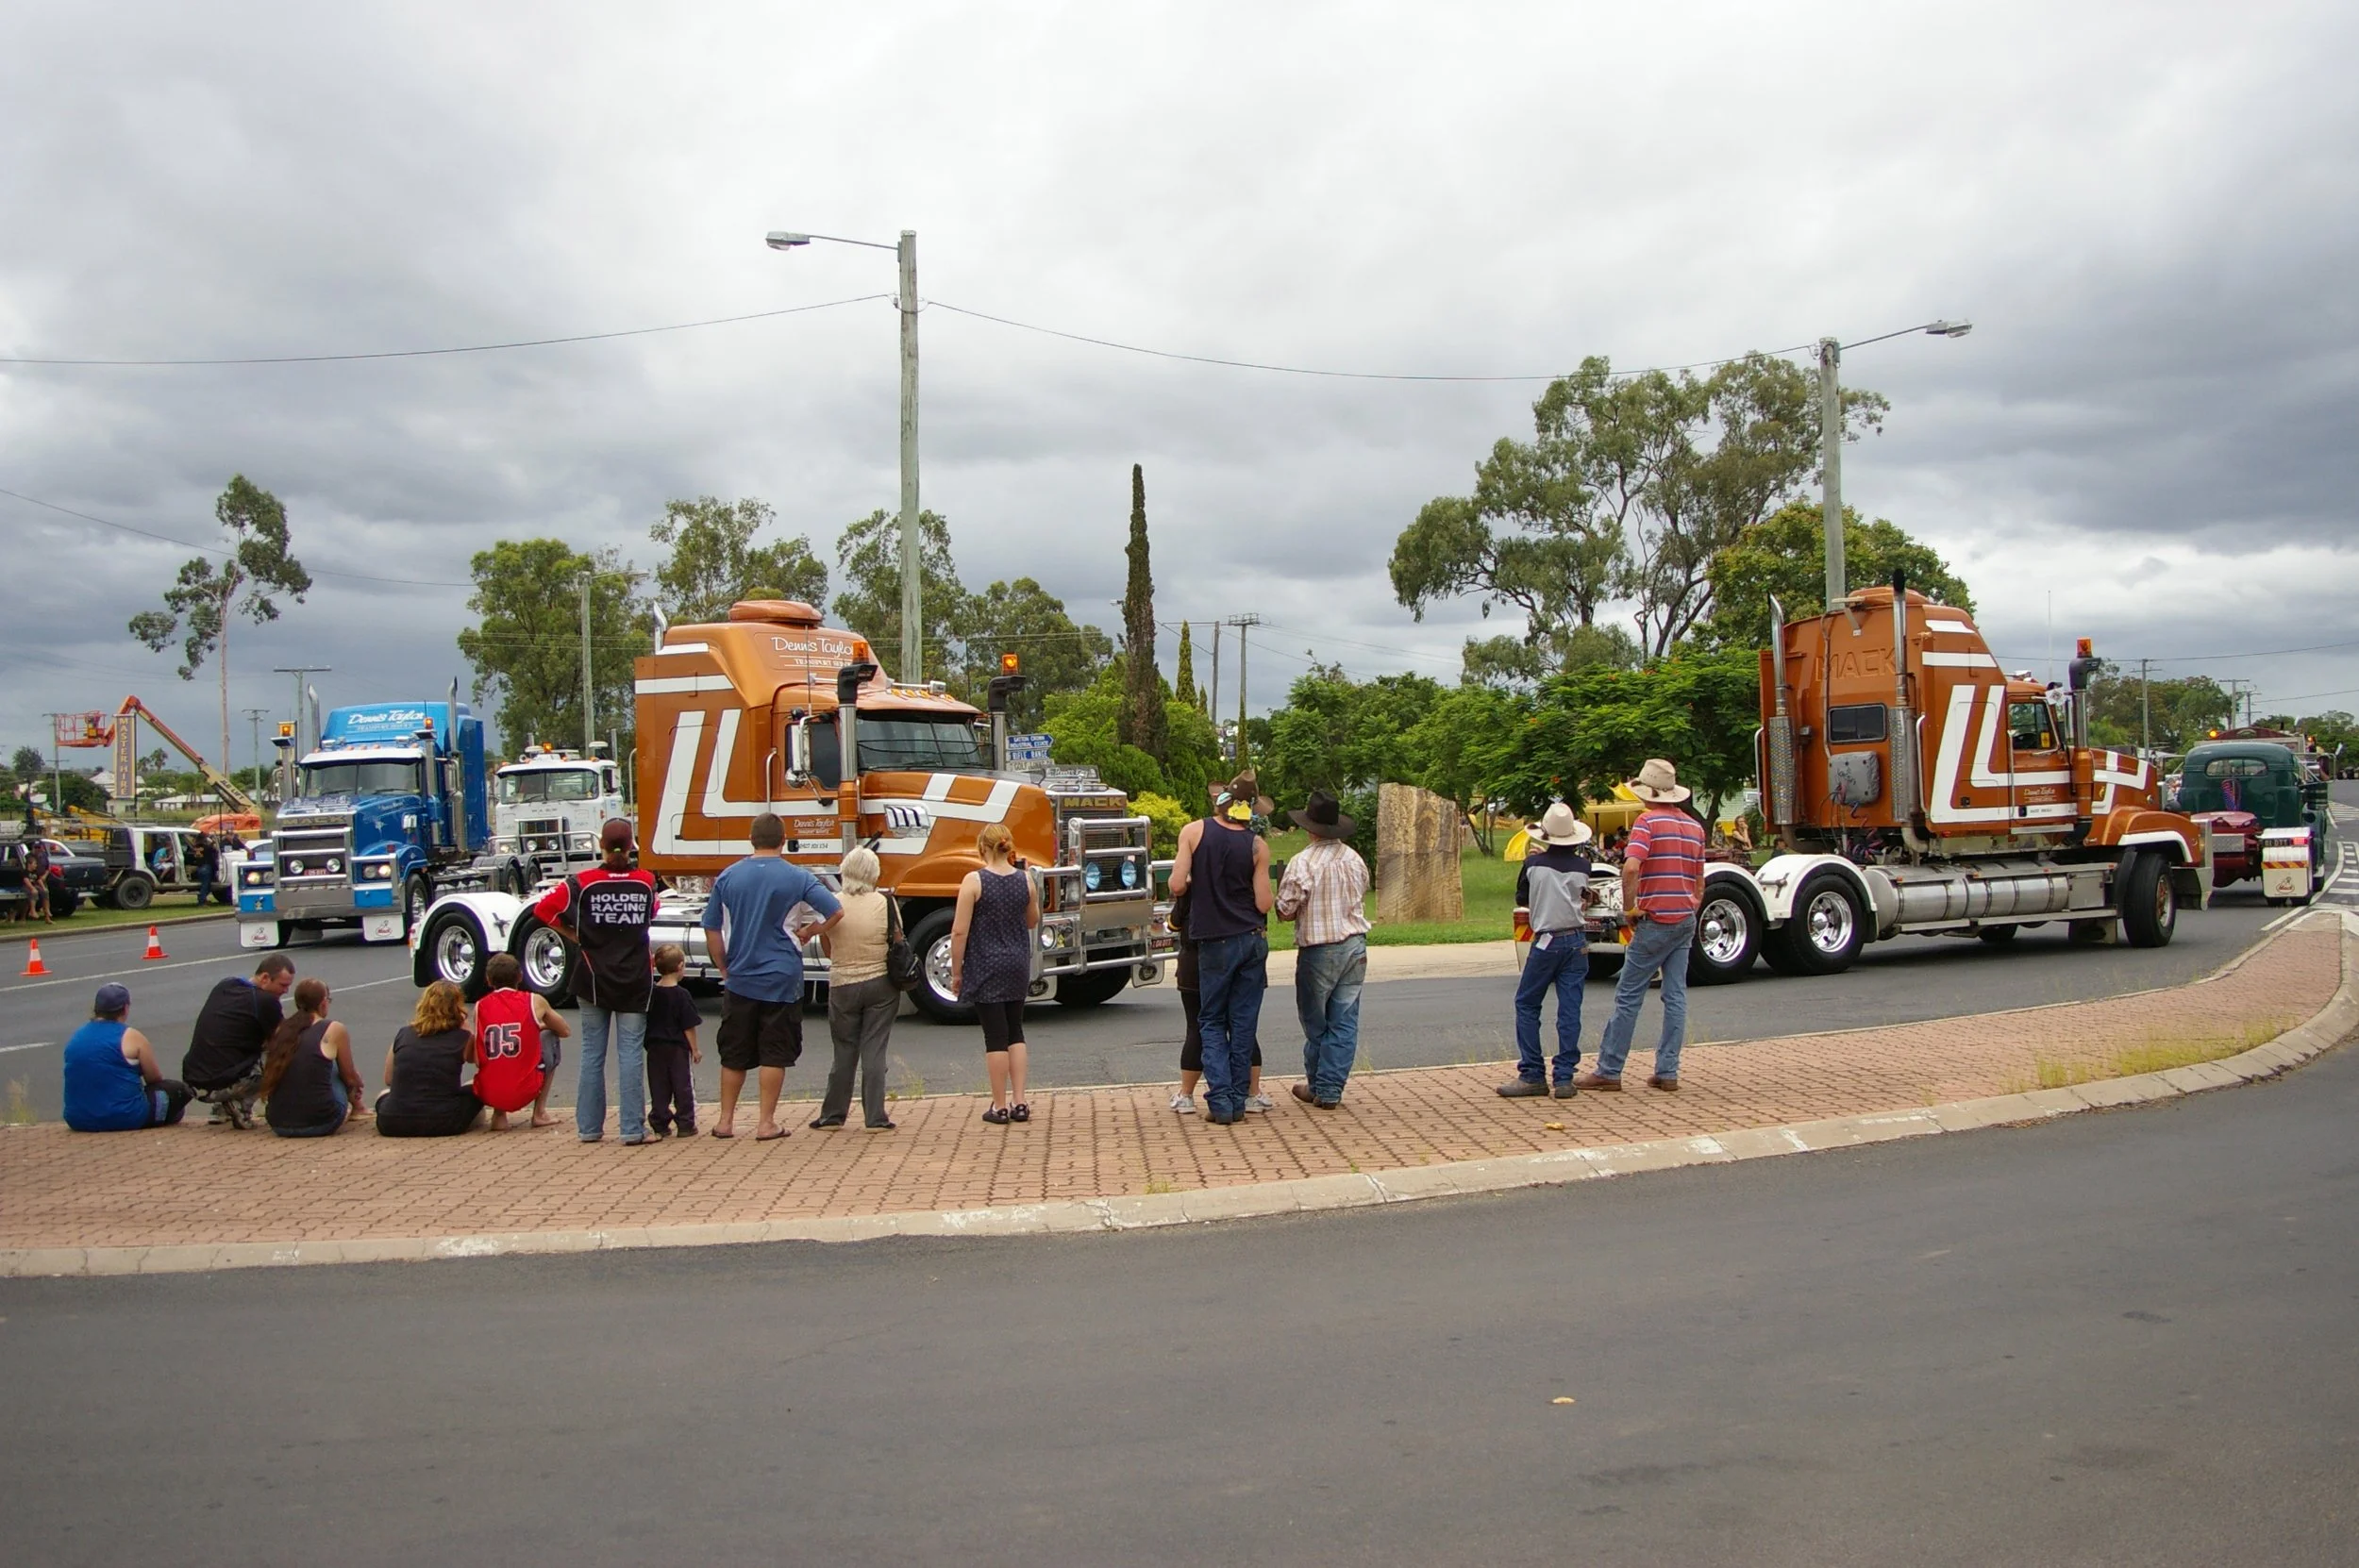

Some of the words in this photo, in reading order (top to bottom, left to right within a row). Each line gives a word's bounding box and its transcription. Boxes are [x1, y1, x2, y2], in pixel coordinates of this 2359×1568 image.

[771, 637, 817, 652] Dennis
[816, 637, 854, 658] Taylo
[348, 713, 387, 725] Dennis
[388, 709, 425, 724] Taylor
[119, 717, 128, 763] MASTER
[1012, 751, 1027, 759] RIFLE
[1031, 750, 1047, 759] RANGE
[119, 765, 128, 795] HIRE
[1063, 796, 1123, 807] MACK
[284, 815, 346, 825] MACK
[591, 893, 647, 903] HOLDEN
[591, 903, 646, 912] RACING
[591, 912, 645, 925] TEAM
[484, 1022, 522, 1059] 05
